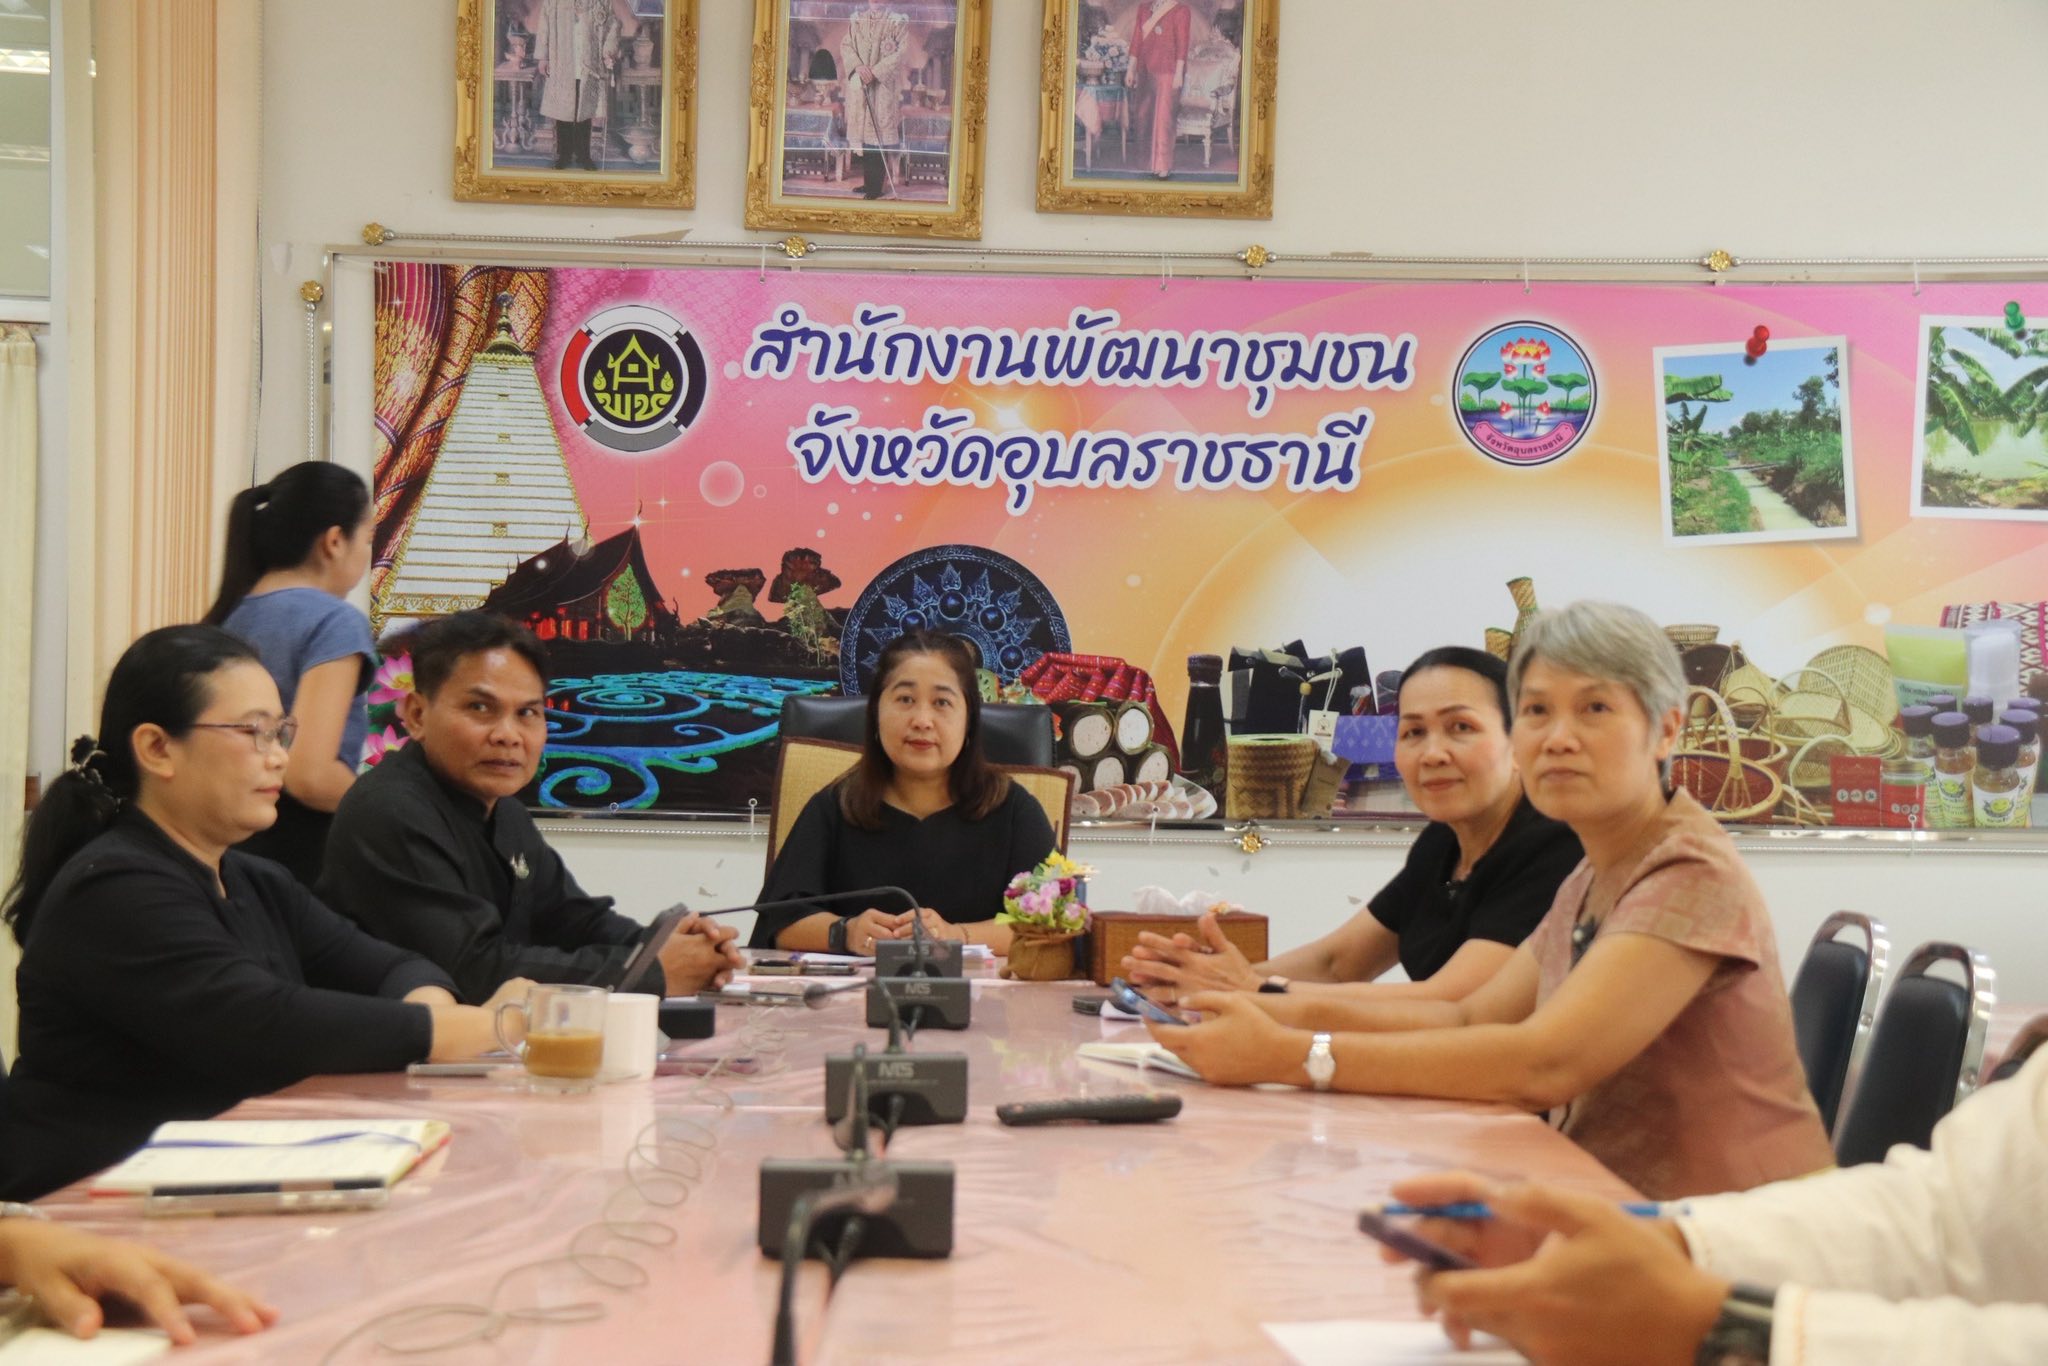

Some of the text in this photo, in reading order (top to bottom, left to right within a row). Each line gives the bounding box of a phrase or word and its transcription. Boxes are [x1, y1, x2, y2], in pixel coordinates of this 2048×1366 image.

[749, 308, 1412, 410] สำนักงานพัฒนาชุมชน
[793, 411, 1369, 511] จังหวัดอุบลราชธานี
